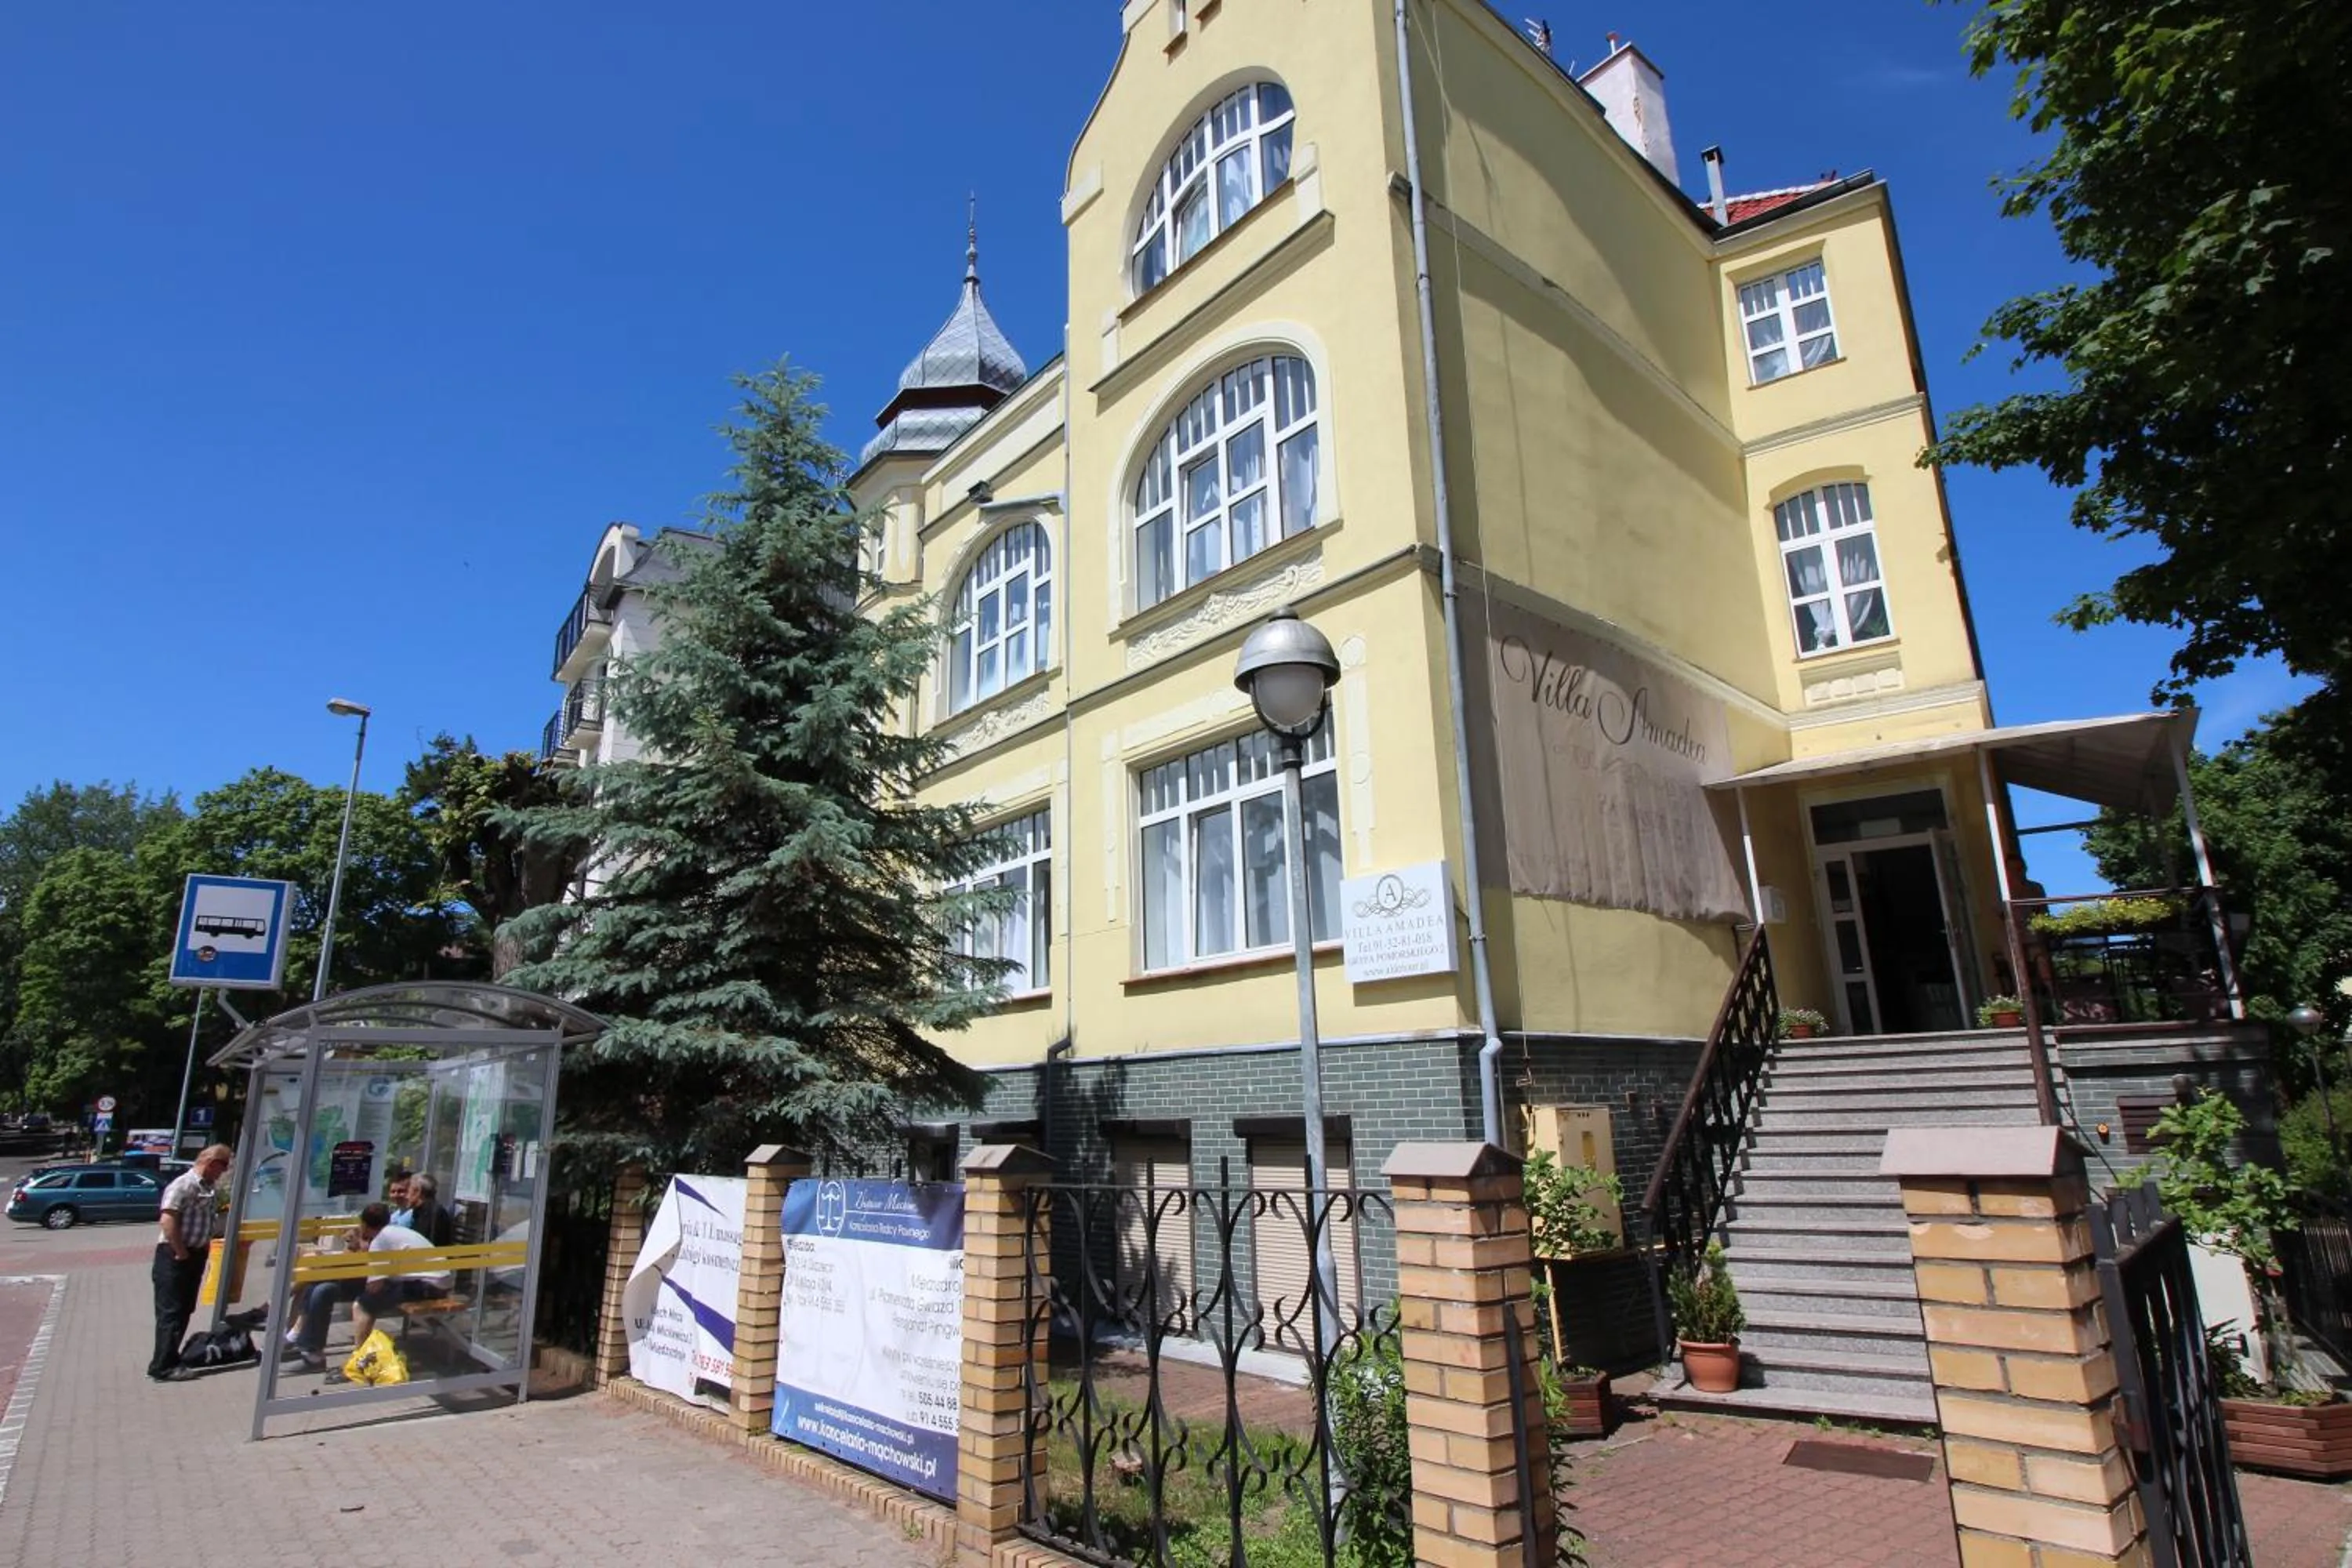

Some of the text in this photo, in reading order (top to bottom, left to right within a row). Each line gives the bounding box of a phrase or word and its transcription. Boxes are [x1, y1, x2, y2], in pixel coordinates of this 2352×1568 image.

[1501, 634, 1708, 766] Villa Amadea
[1385, 883, 1396, 903] A
[1345, 914, 1443, 940] VILLA AMADEA
[197, 1109, 205, 1121] 1
[931, 1414, 937, 1426] 4
[938, 1415, 954, 1431] 555
